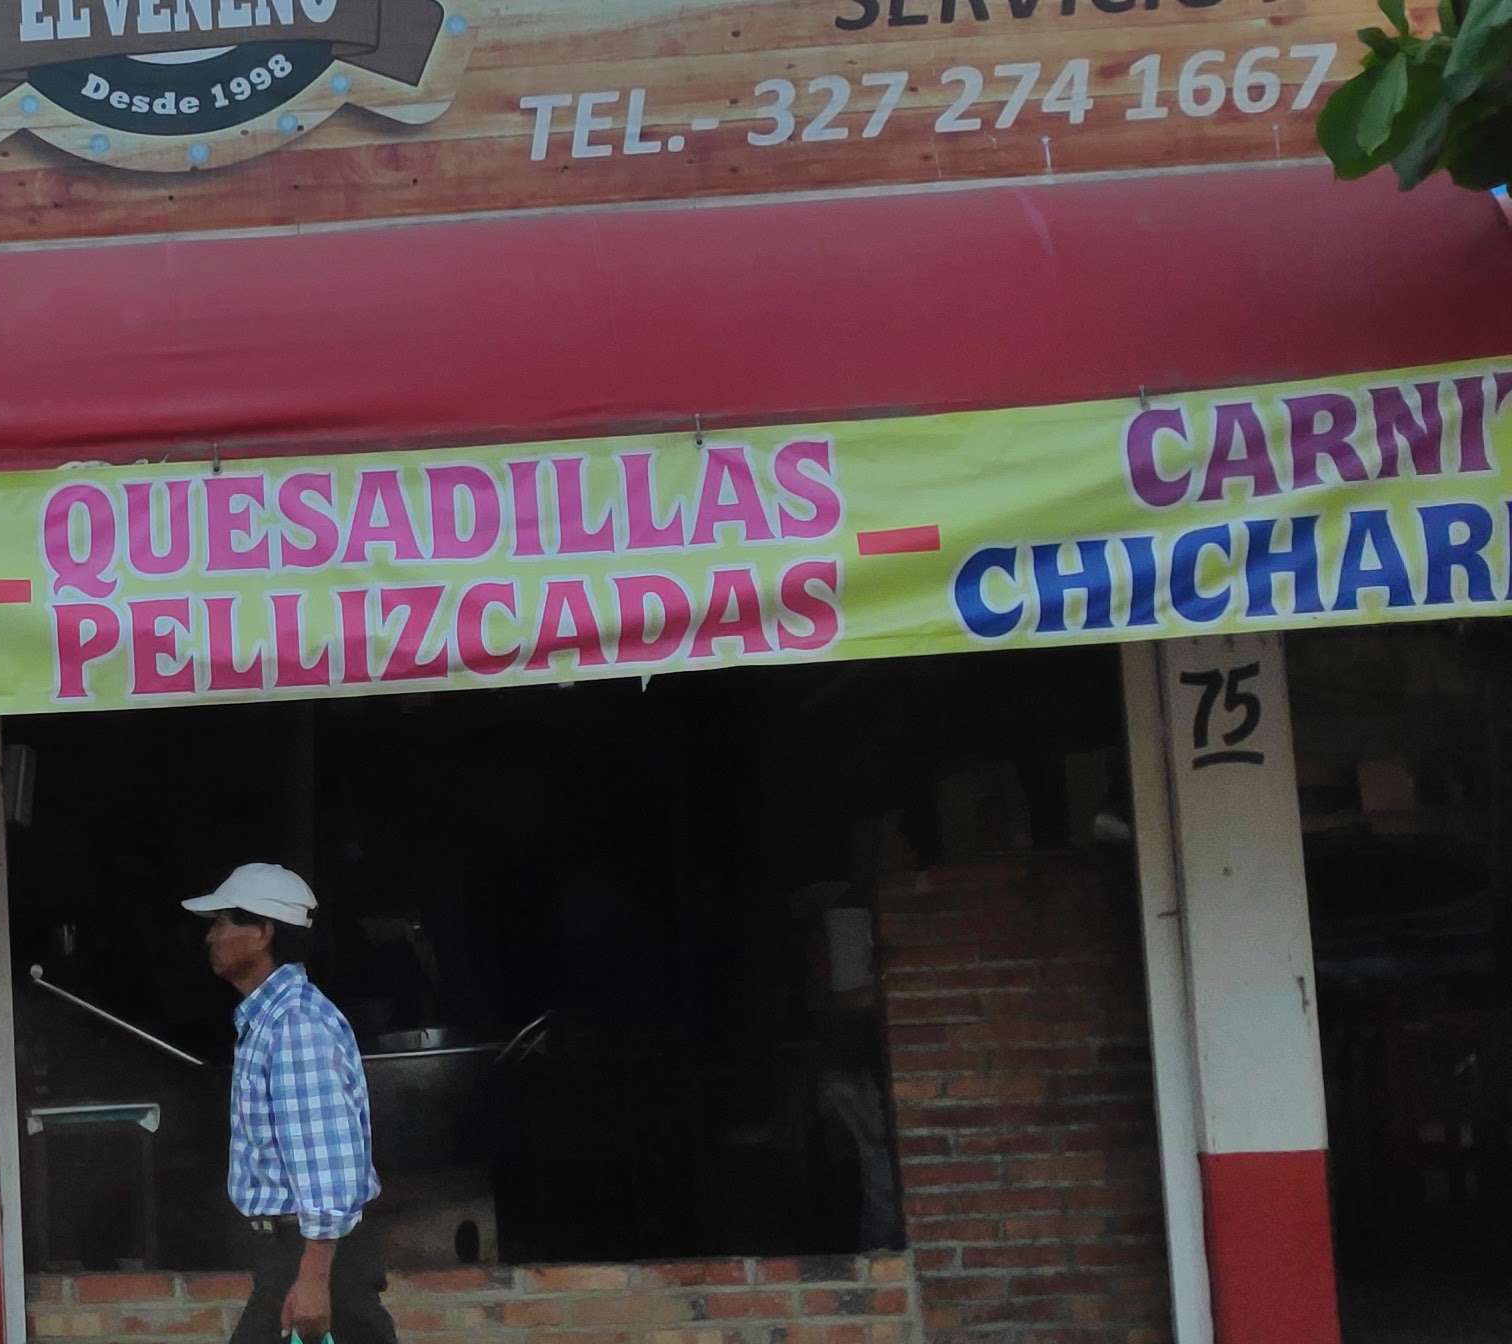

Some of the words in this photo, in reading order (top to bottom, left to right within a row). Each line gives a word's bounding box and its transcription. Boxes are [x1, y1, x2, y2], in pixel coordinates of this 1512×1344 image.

[80, 72, 200, 115] Desde
[213, 53, 293, 108] 1998
[746, 71, 909, 148] 327
[933, 59, 1093, 134] 274
[1126, 42, 1337, 122] 1667
[44, 440, 842, 599] QUESADILLAS
[954, 500, 1511, 638] CHICHAR
[53, 560, 840, 699] PELLIZCADAS
[1179, 661, 1262, 750] 75
